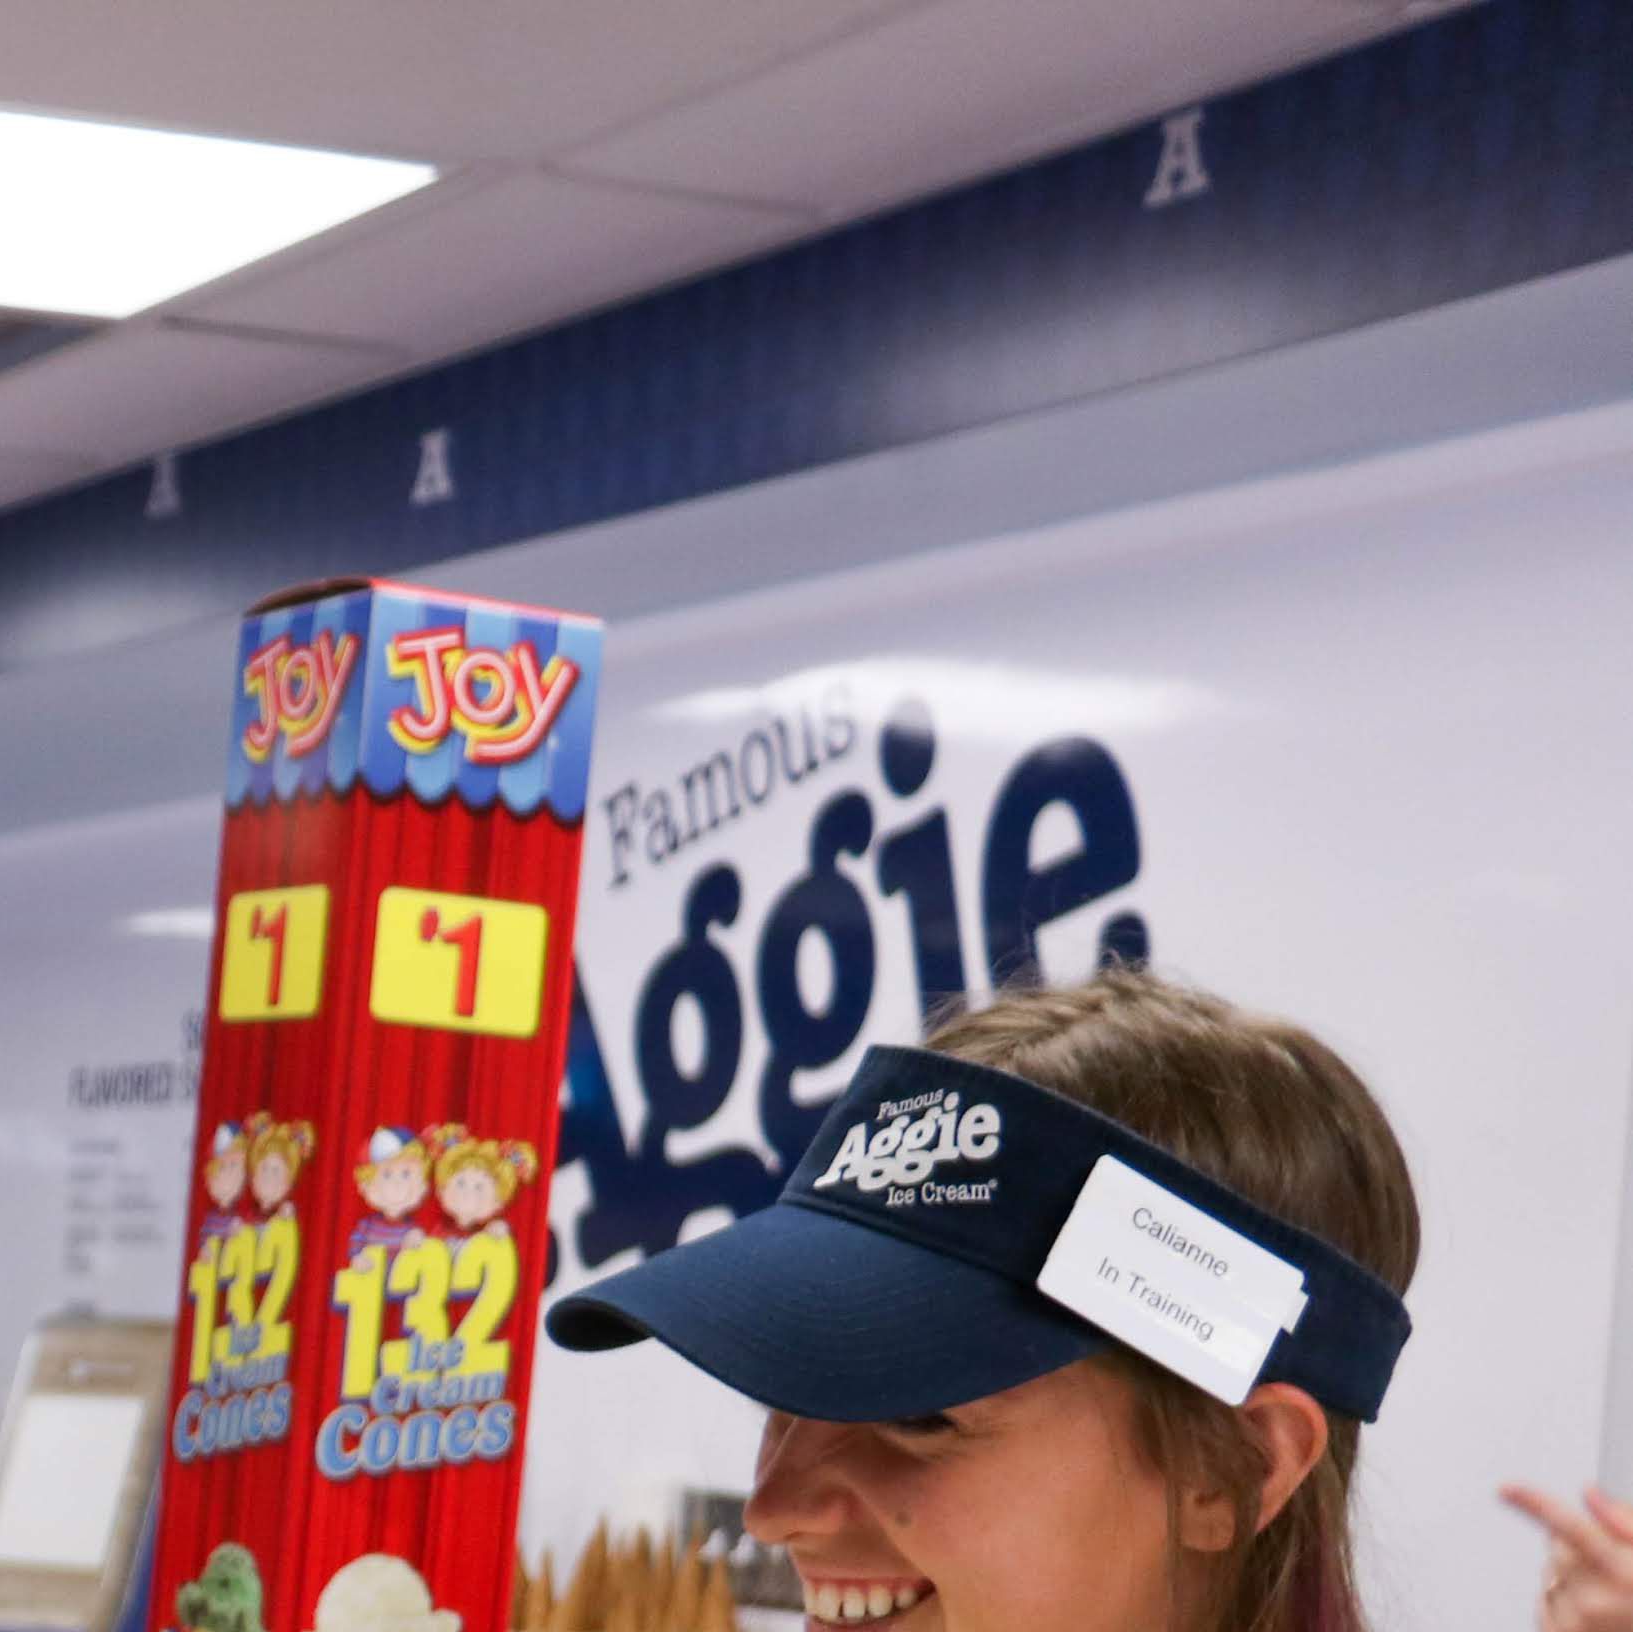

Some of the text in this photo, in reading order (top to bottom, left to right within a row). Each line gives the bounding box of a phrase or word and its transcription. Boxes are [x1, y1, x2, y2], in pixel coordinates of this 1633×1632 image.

[603, 682, 857, 888] Famous
[813, 1091, 1001, 1193] Aggie
[876, 1088, 944, 1121] Famous
[886, 1185, 915, 1206] Ice
[1132, 1206, 1229, 1279] Calianne
[189, 1215, 299, 1385] 132
[333, 1230, 519, 1402] 132
[1097, 1257, 1215, 1342] In Training
[173, 1381, 292, 1463] Cones
[371, 1371, 506, 1415] Cream
[315, 1400, 517, 1482] Cones
